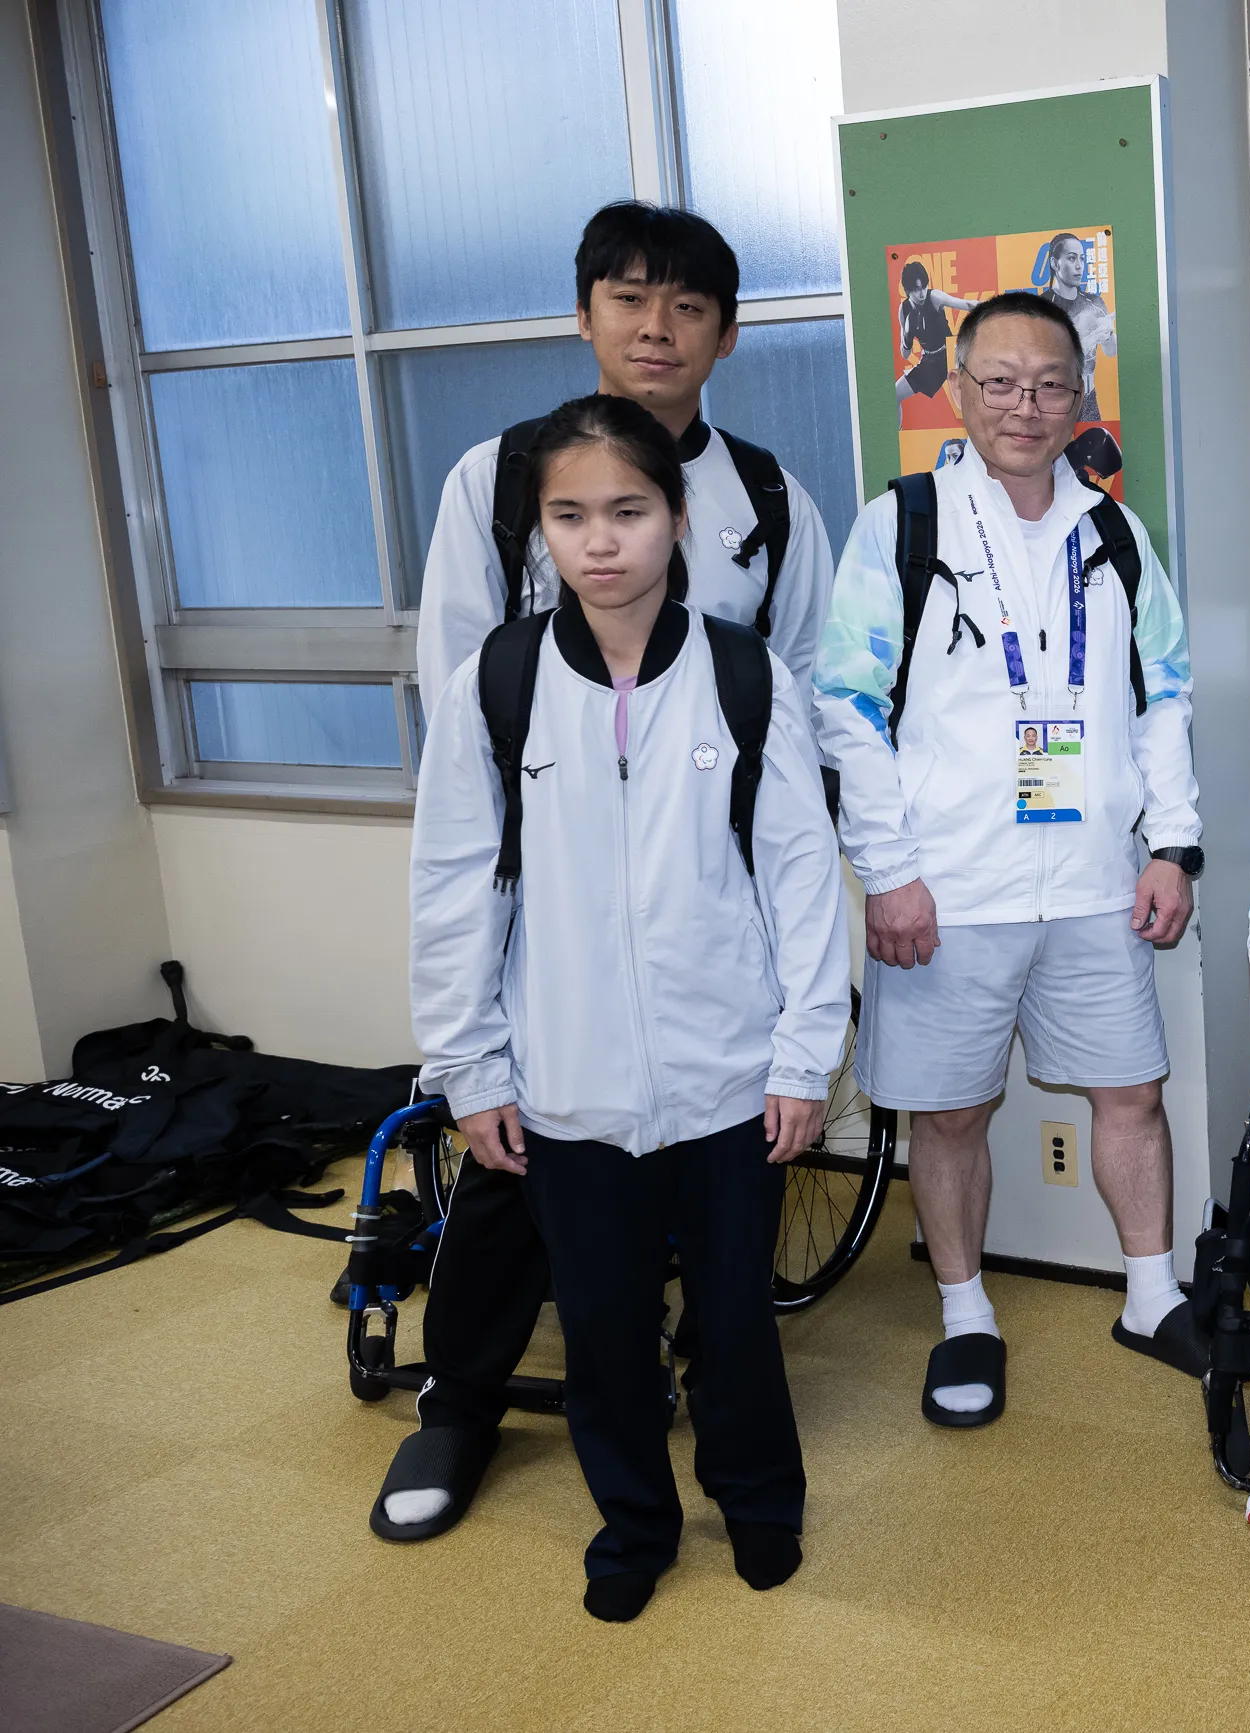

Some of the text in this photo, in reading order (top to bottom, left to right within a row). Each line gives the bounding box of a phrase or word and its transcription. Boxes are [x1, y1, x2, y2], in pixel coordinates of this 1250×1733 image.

[976, 520, 987, 539] 2026
[982, 540, 1002, 591] Aichi-Nagoya
[1070, 530, 1081, 594] ichi-Nagoya 2026
[1051, 812, 1056, 820] 2
